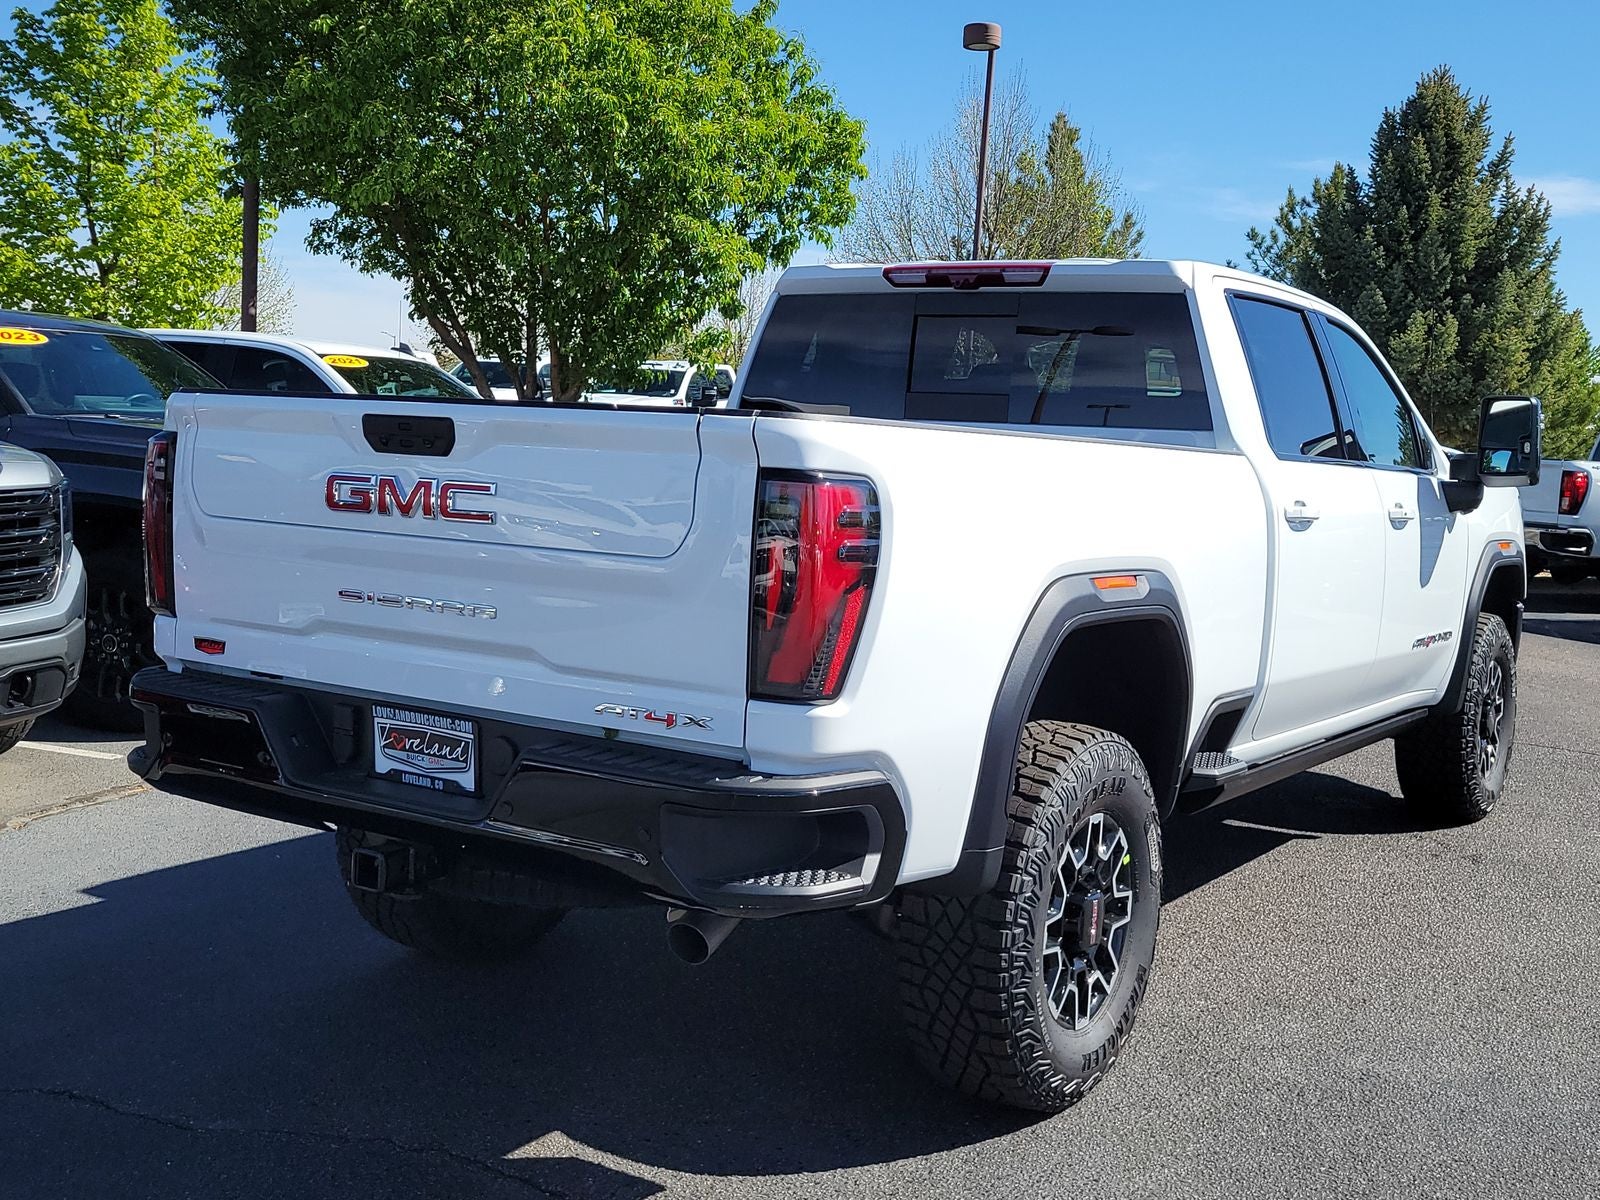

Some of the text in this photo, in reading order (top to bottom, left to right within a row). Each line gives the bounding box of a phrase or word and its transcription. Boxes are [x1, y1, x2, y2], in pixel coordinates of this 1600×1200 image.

[0, 331, 41, 342] 023
[325, 471, 497, 525] GMC
[338, 588, 498, 620] SIERRA
[594, 702, 714, 731] AT4X
[406, 752, 446, 767] BUICK GMC
